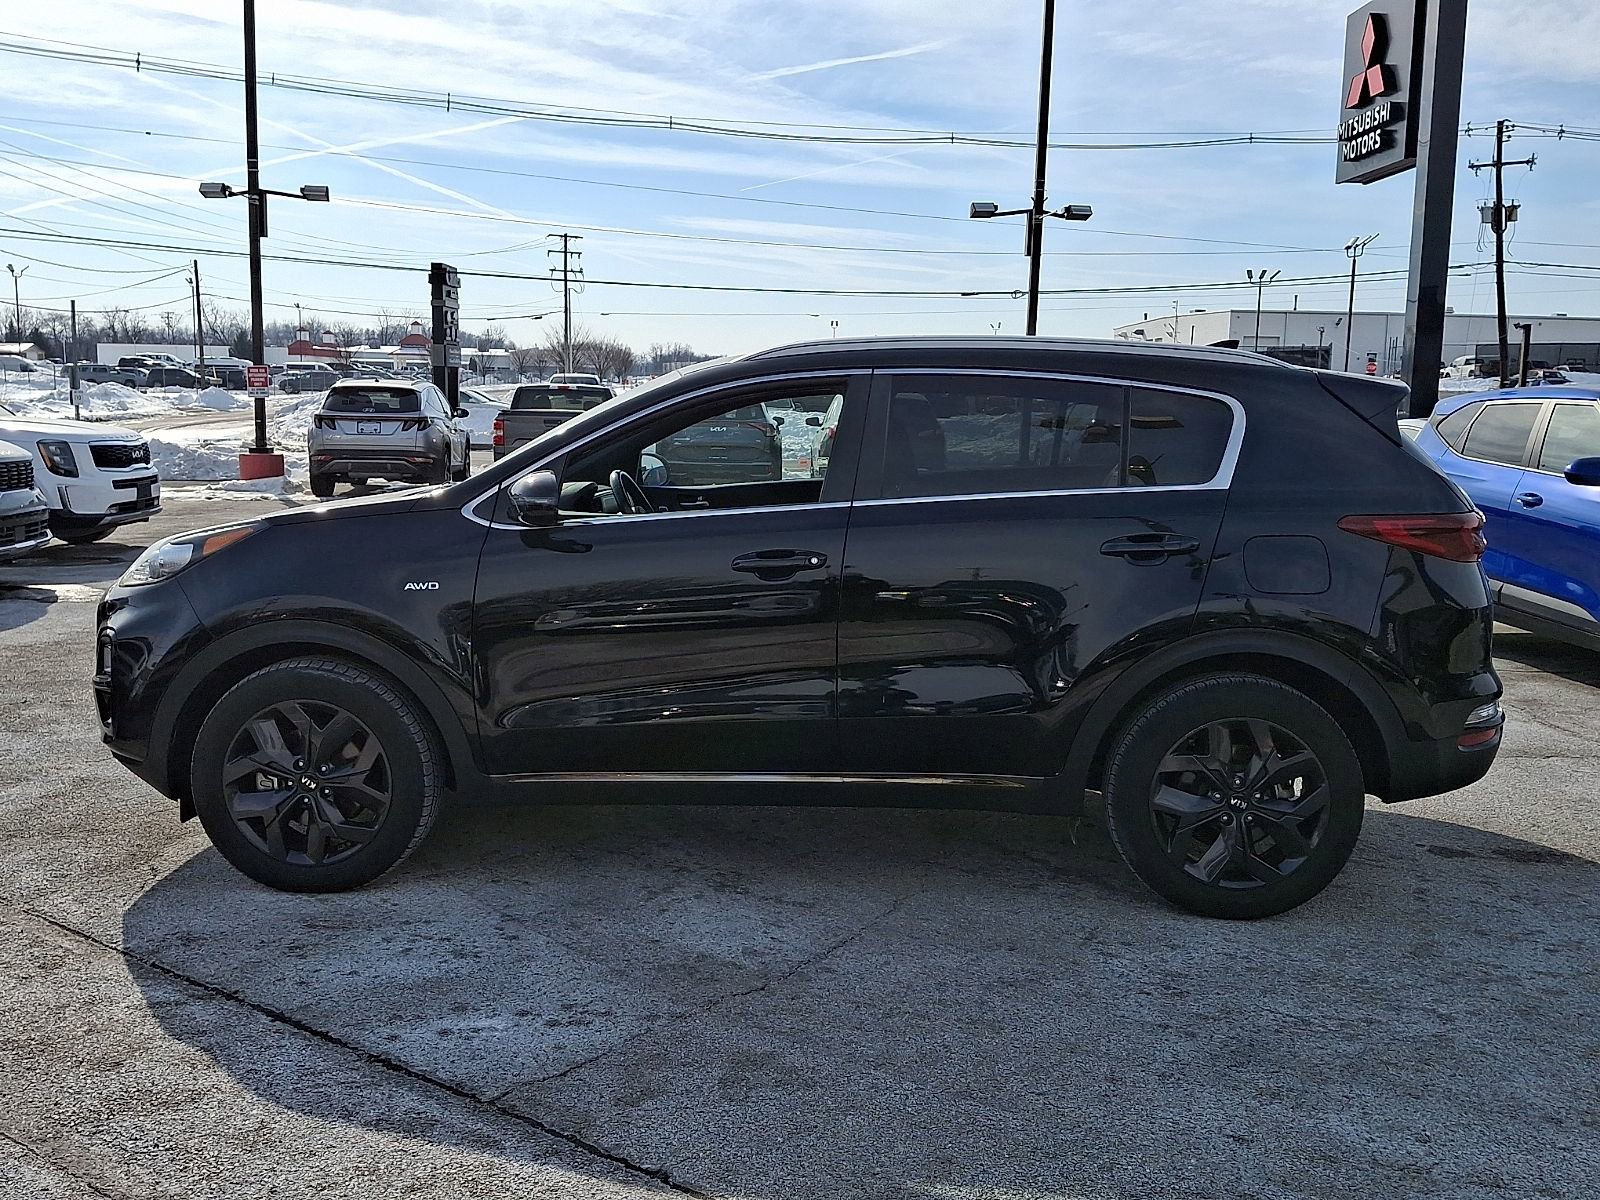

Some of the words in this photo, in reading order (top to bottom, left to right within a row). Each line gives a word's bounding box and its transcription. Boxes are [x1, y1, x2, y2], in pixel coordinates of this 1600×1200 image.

[1338, 101, 1390, 140] MITSUBISHI
[1342, 129, 1381, 161] MOTORS
[404, 582, 439, 590] AWD
[301, 775, 317, 790] KIA
